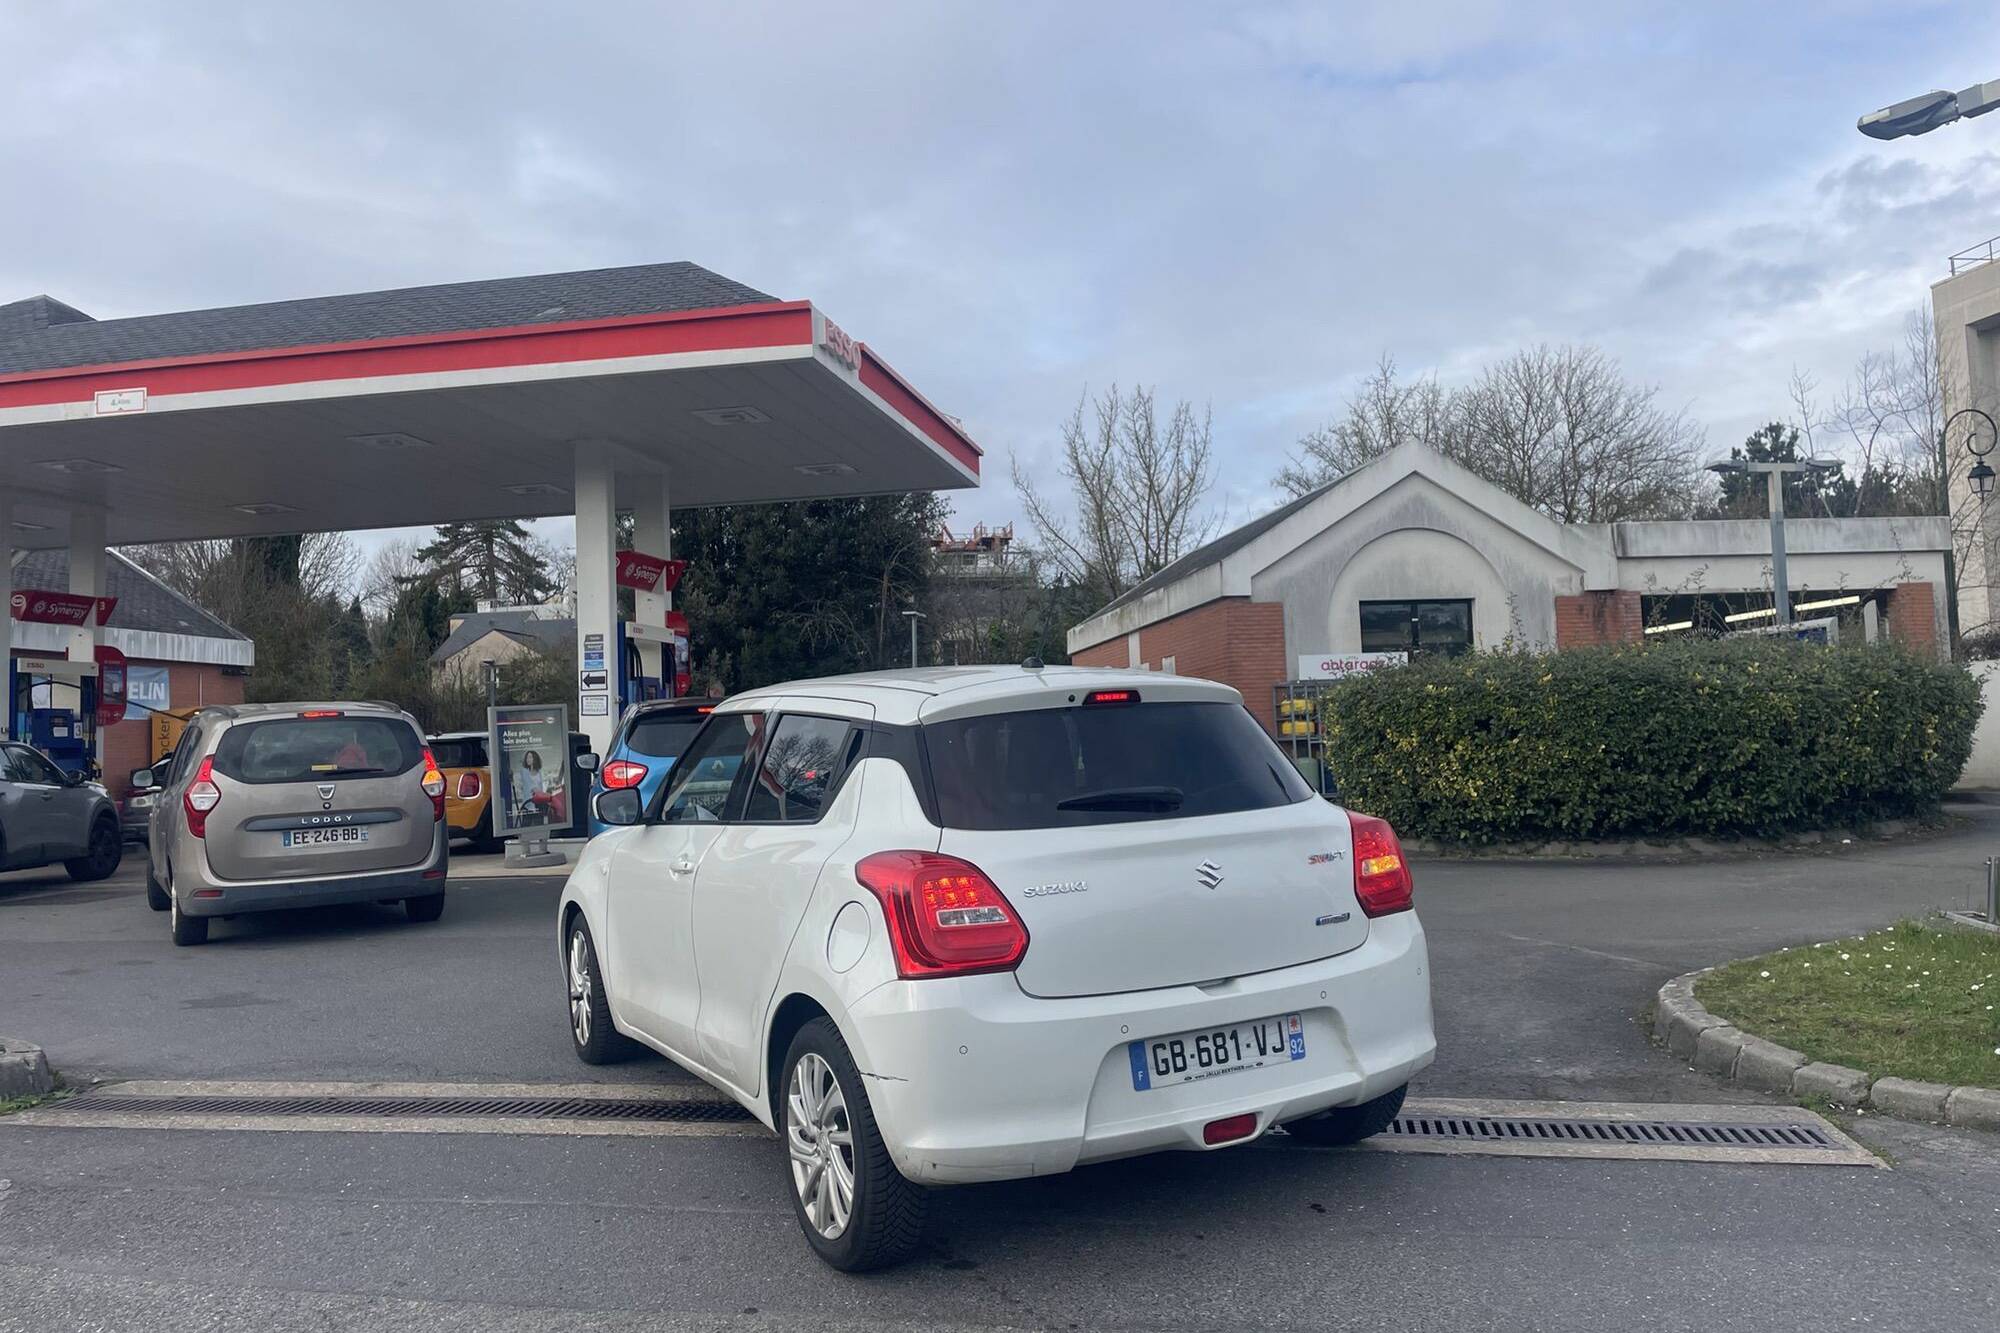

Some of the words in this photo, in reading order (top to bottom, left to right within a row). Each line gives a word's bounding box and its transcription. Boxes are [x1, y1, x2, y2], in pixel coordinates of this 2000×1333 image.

[634, 566, 659, 583] Synergy
[669, 565, 676, 576] 1
[47, 602, 88, 619] Synergy
[301, 815, 353, 824] LODGY
[293, 828, 358, 844] EE-246-BB
[1023, 880, 1088, 898] SUZUKI
[1152, 1021, 1286, 1077] GB-681-VJ
[1290, 1038, 1305, 1055] 92
[1137, 1070, 1144, 1081] F
